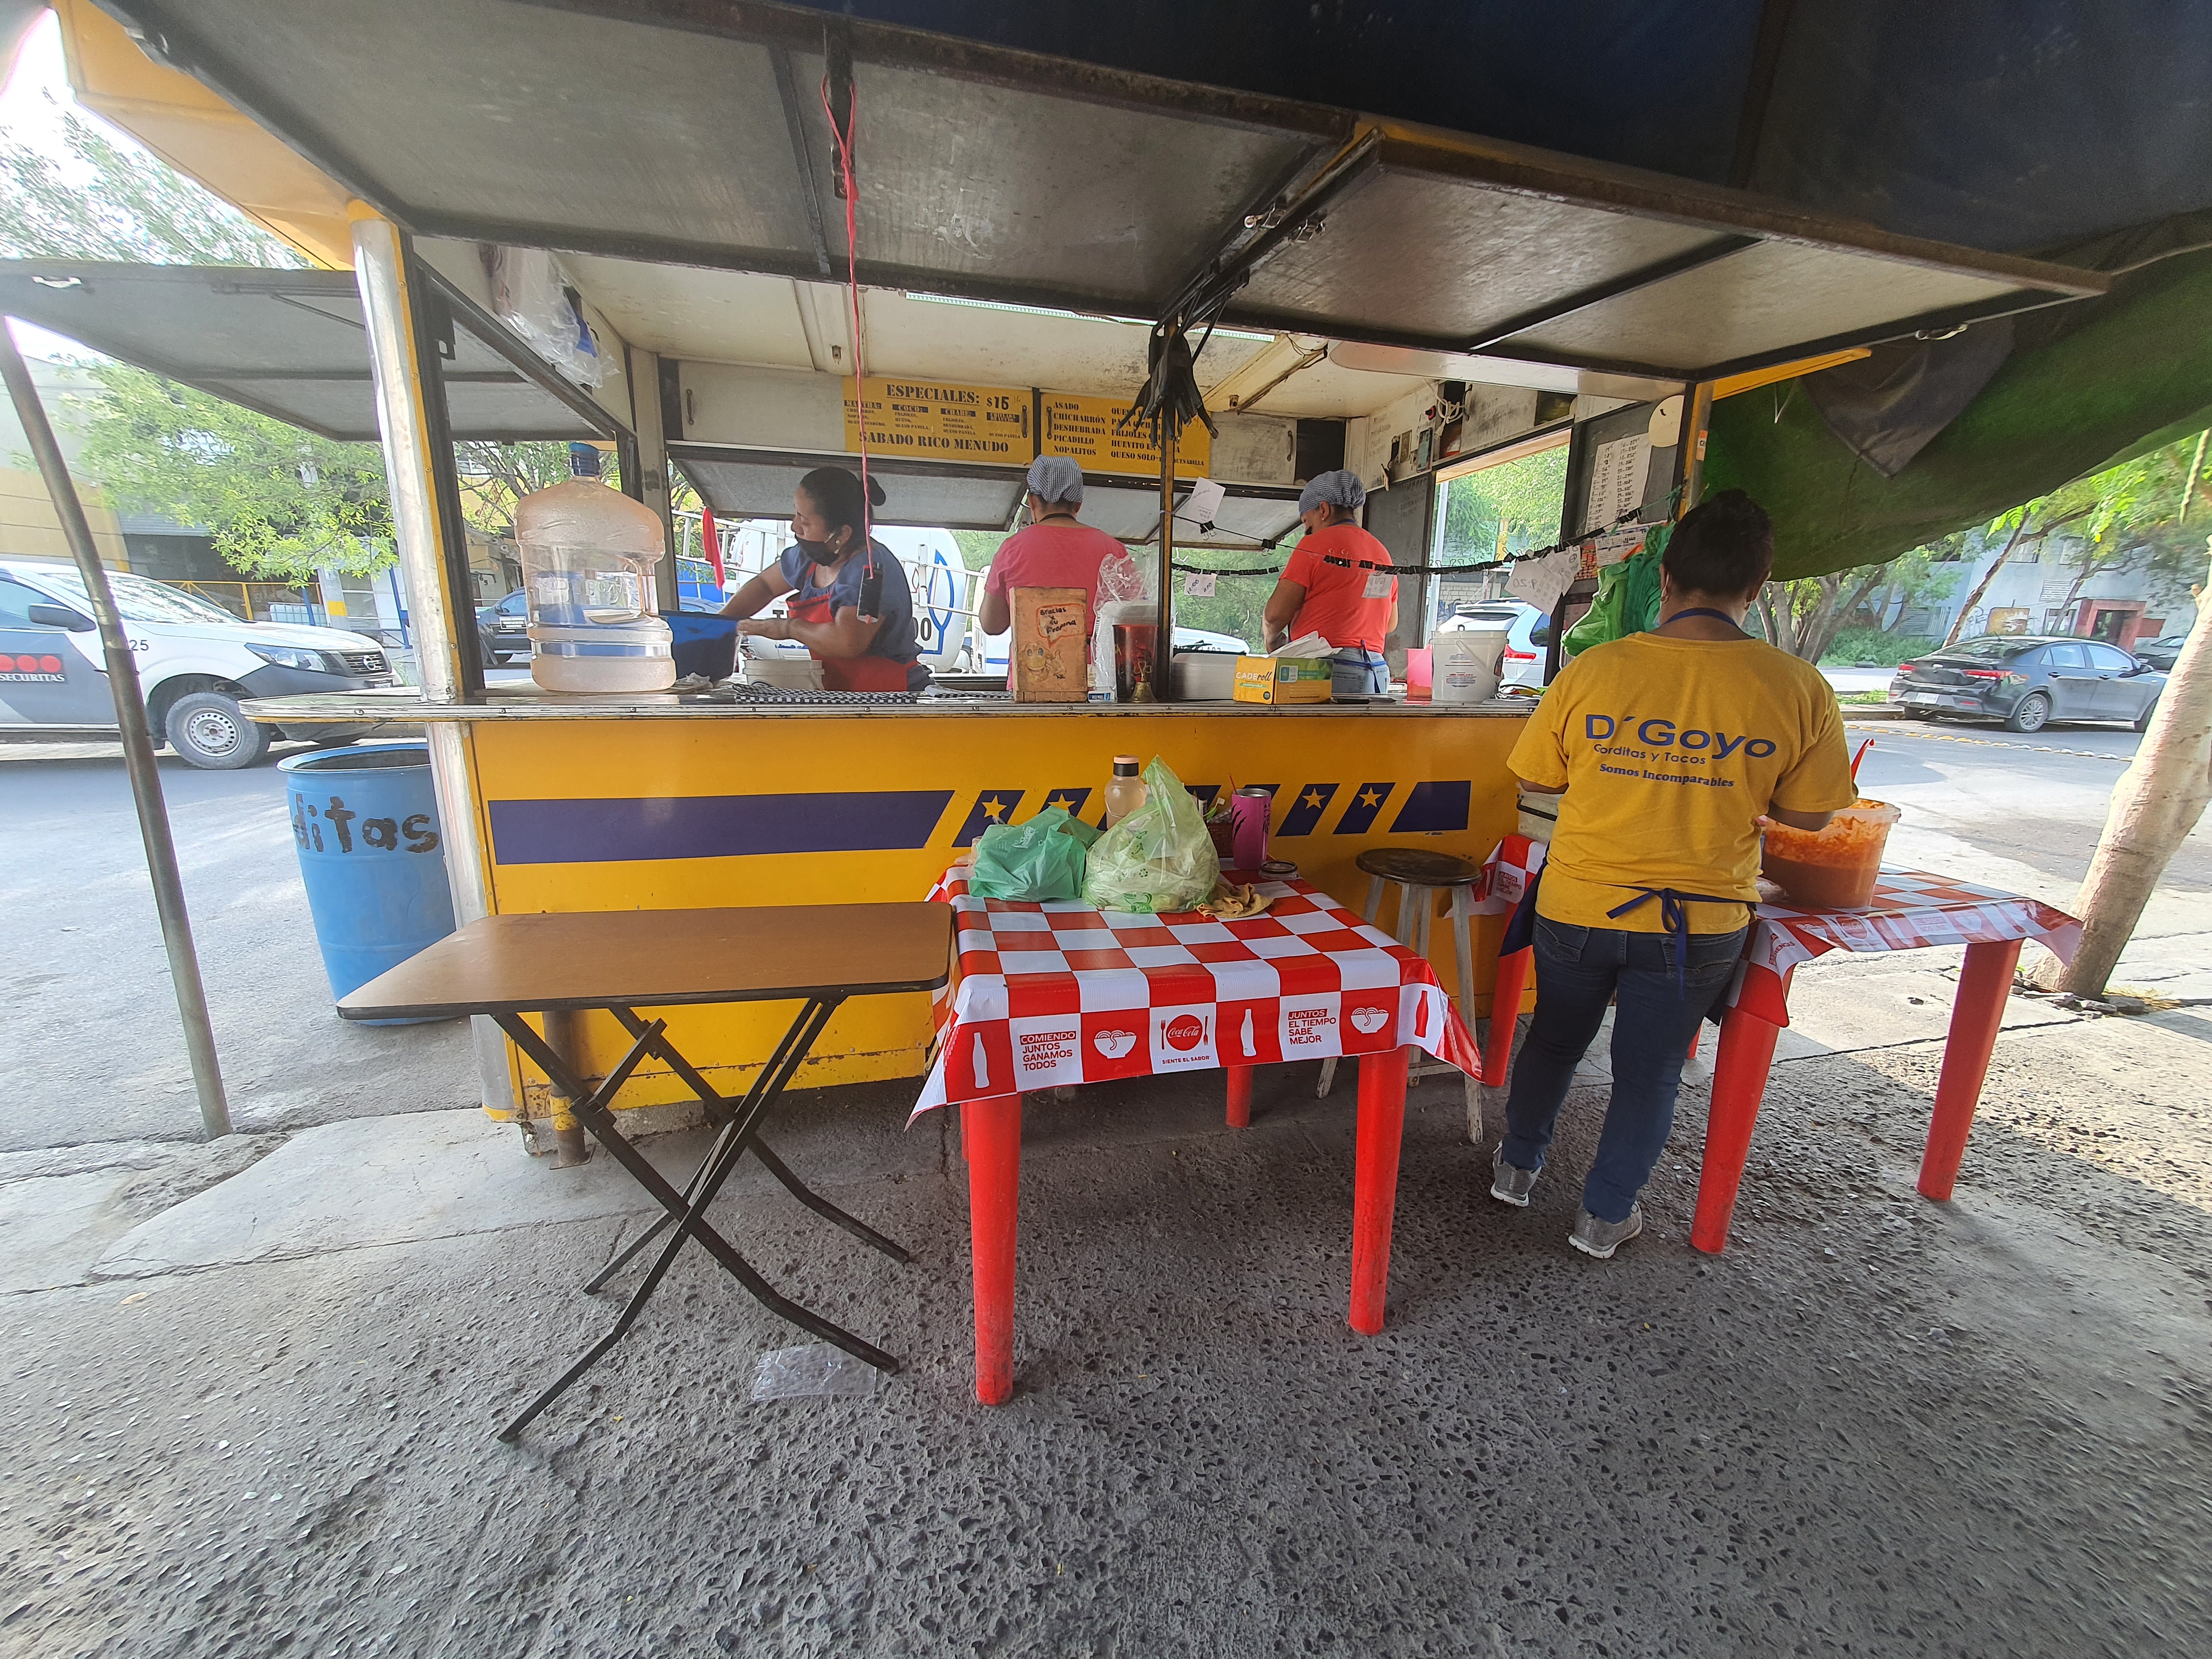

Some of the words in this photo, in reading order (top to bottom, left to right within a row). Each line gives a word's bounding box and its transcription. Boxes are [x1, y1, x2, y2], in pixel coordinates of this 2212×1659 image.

[887, 384, 979, 404] ESPECIALES:
[986, 396, 1010, 410] $15
[846, 400, 881, 409] MATHA:
[898, 405, 923, 413] COCO:
[1054, 402, 1079, 410] ASADO
[1054, 412, 1106, 423] CHICHARRÓN
[1111, 408, 1133, 416] QUES
[1112, 418, 1131, 426] PA
[1054, 423, 1106, 435] DESHEBRADA
[1112, 429, 1146, 439] FRIJOLES
[859, 432, 914, 445] SABADO
[918, 435, 950, 448] RICO
[954, 438, 1009, 453] MENUDO
[1054, 434, 1094, 445] PICADILLO
[1111, 440, 1145, 450] HUEVITO
[1054, 445, 1097, 456] NOPALITOS
[1111, 450, 1135, 459] QUESO
[1137, 453, 1156, 461] SOLO
[0, 673, 65, 683] SECURITAS
[1651, 752, 1659, 762] y
[1664, 752, 1706, 765] Tacos
[1599, 763, 1639, 777] Somos
[1642, 769, 1734, 787] Incomparables
[1289, 1010, 1325, 1019] JUNTOS
[1302, 1017, 1336, 1027] TIEMPO
[1289, 1027, 1313, 1036] SABE
[1021, 1032, 1075, 1044] COMIENDO
[1289, 1035, 1322, 1045] MEJOR
[1022, 1042, 1060, 1054] JUNTOS
[1023, 1049, 1073, 1062] GANAMOS
[1023, 1060, 1057, 1071] TODOS
